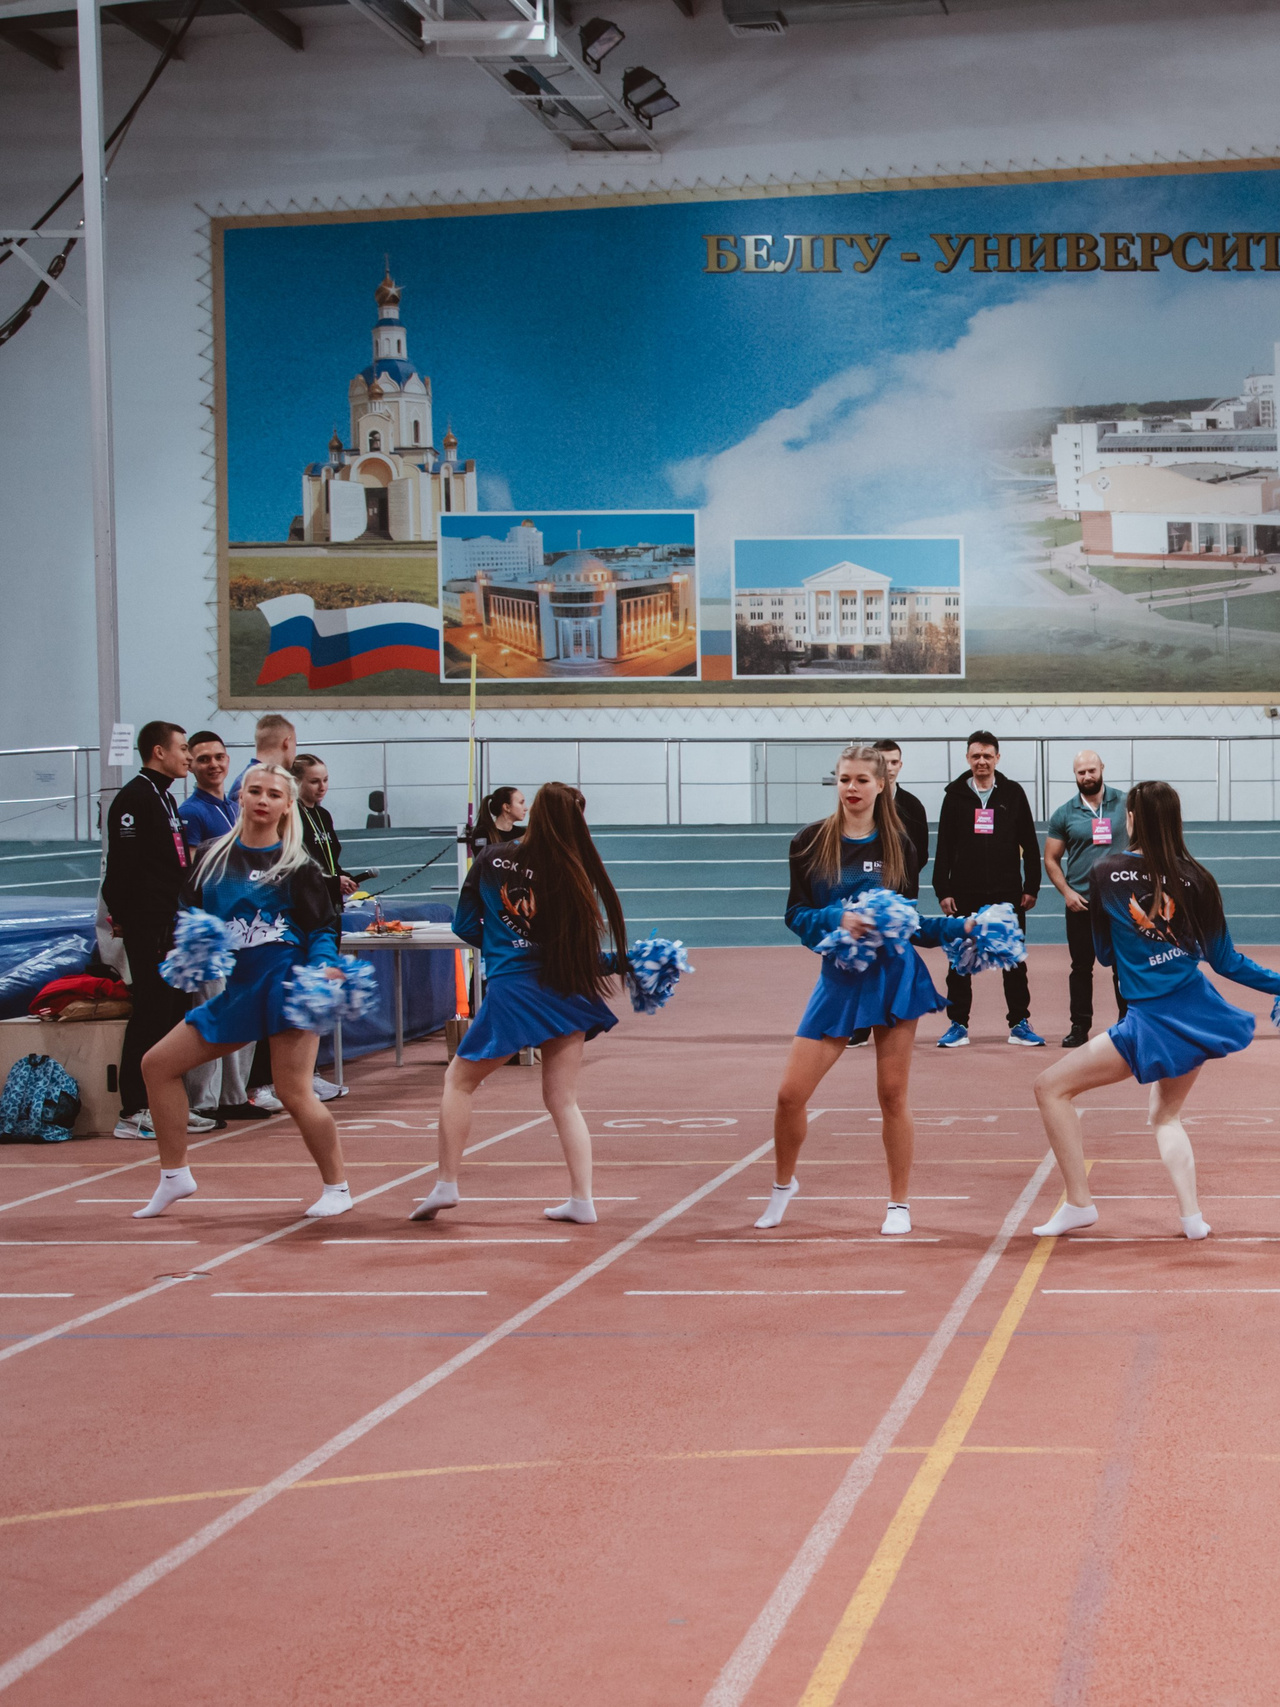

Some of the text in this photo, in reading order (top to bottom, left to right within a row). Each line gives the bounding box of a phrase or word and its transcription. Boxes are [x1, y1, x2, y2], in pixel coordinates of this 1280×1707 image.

[702, 233, 891, 273] БЕЛГУ
[493, 858, 519, 872] ССК
[1110, 869, 1138, 882] ССК
